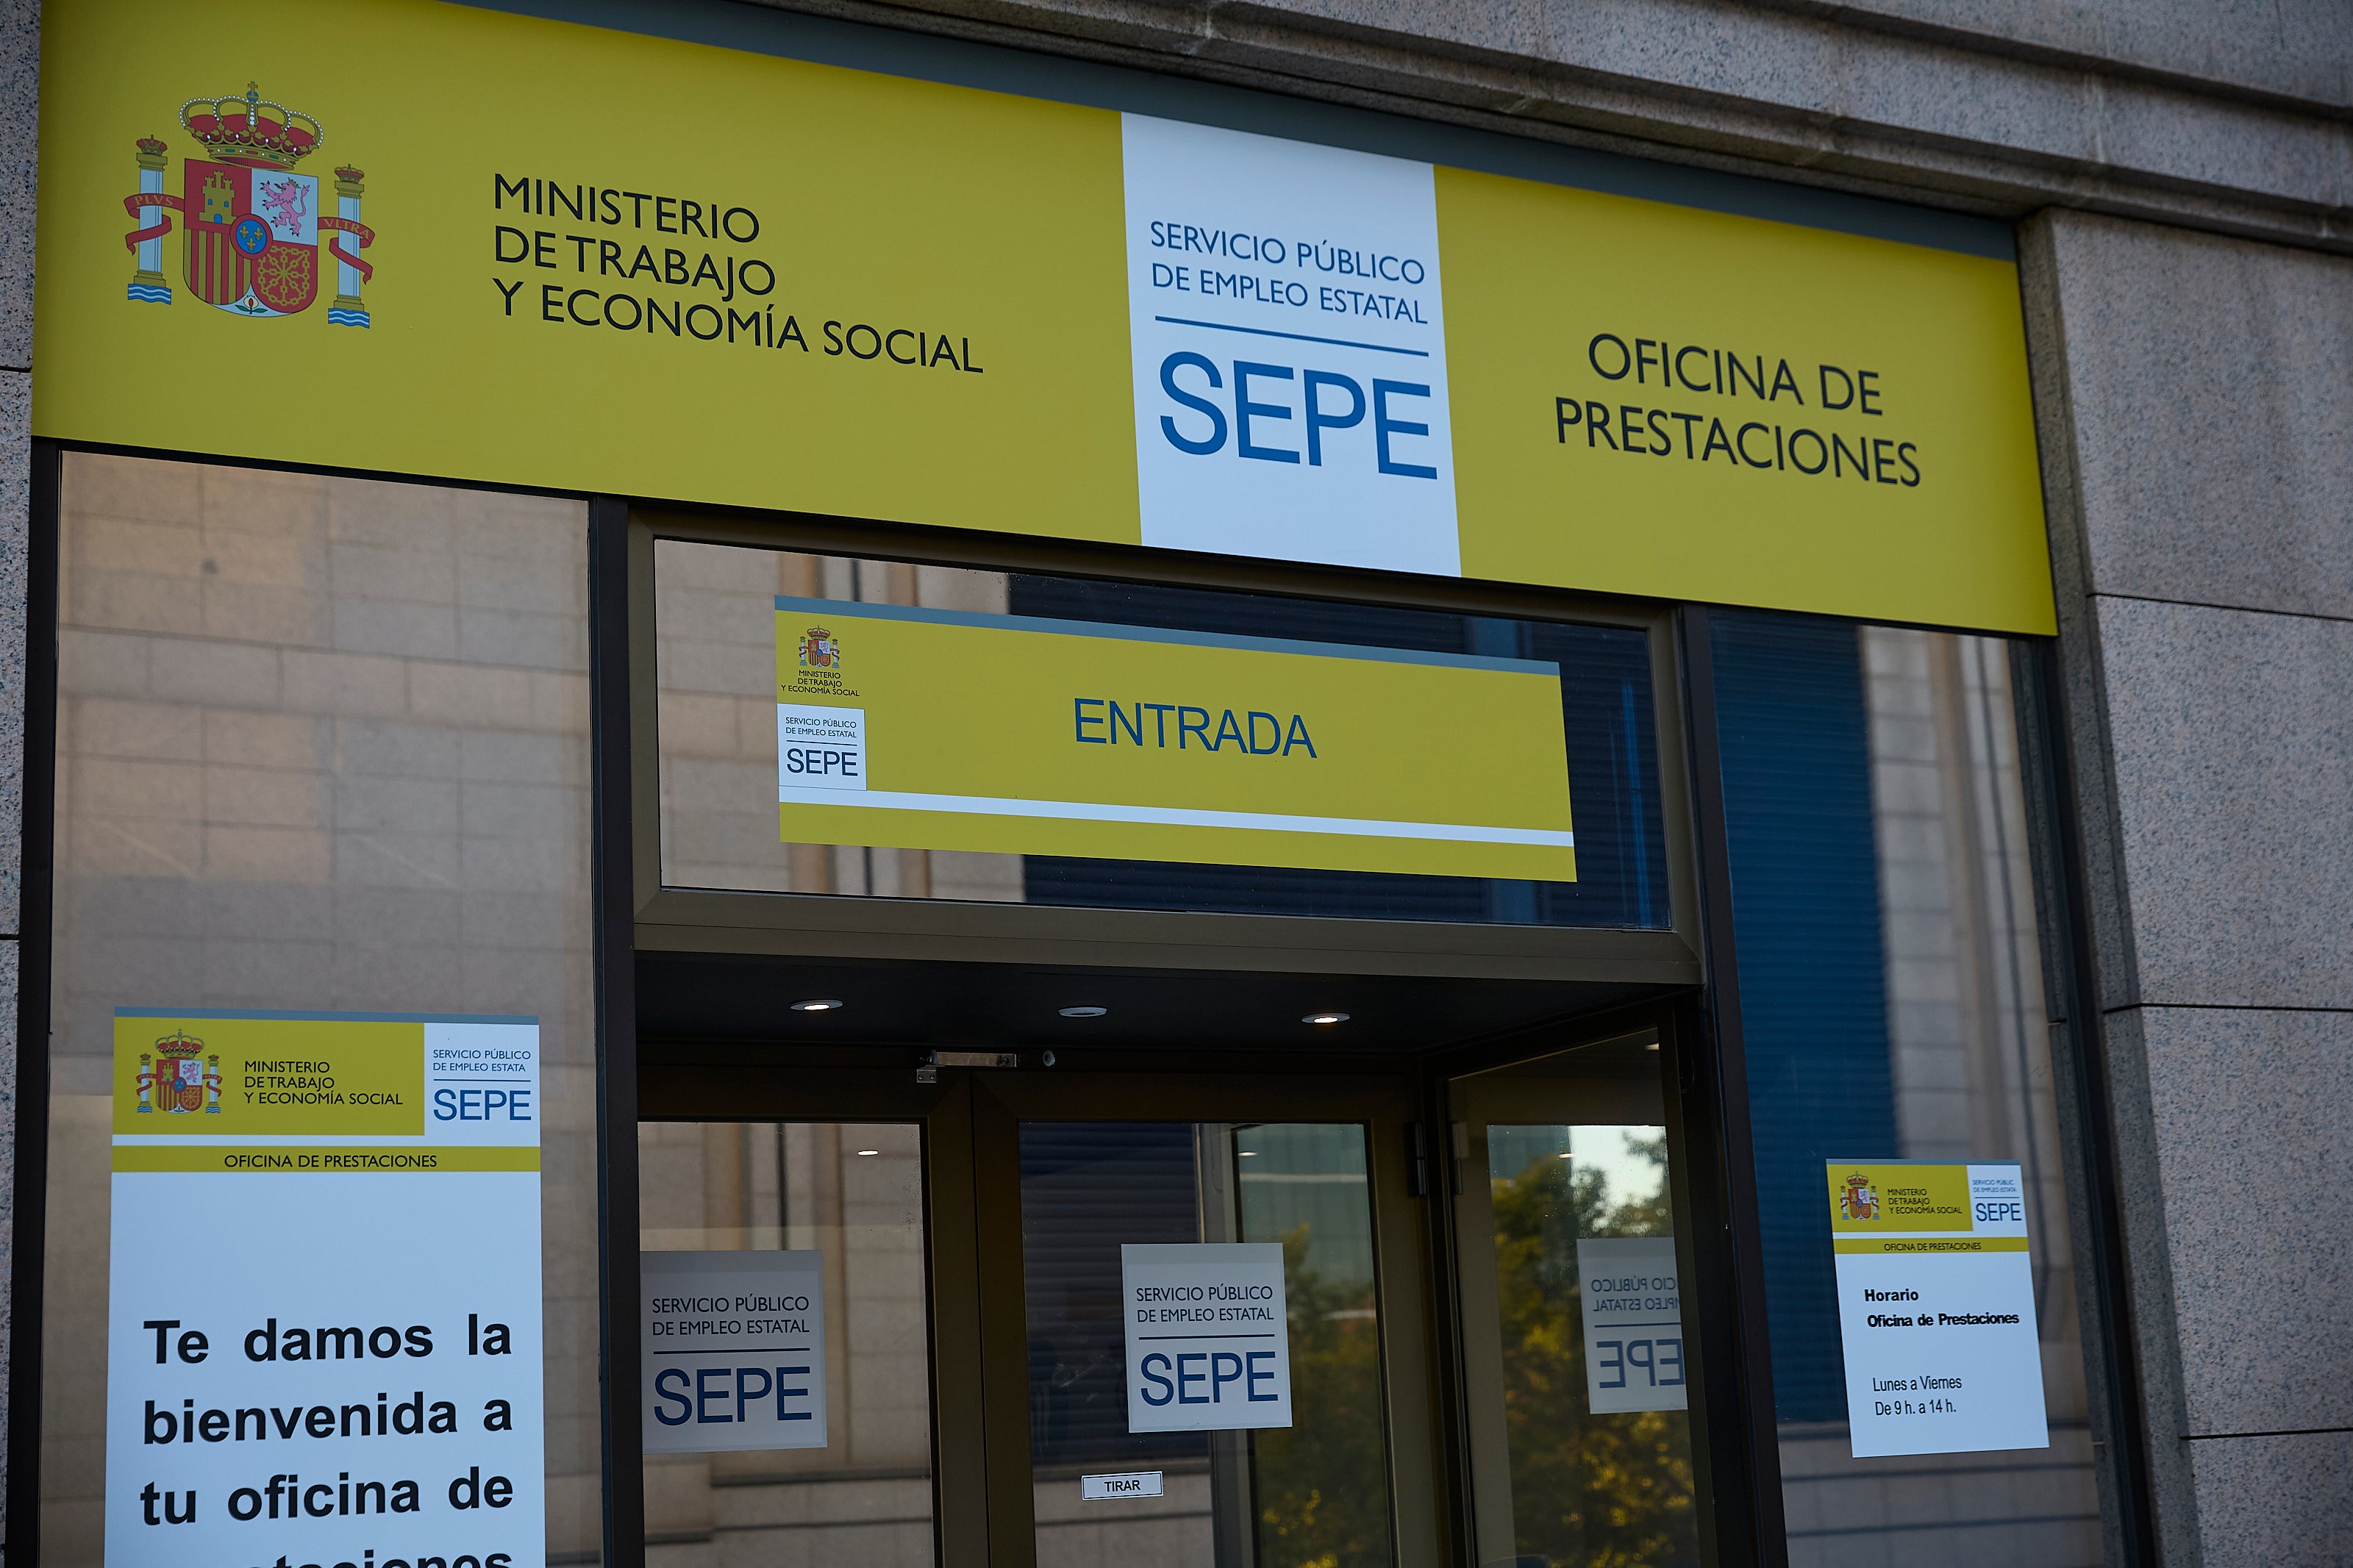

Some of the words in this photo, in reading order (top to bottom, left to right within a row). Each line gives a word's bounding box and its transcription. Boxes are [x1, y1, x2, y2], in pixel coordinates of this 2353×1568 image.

[134, 196, 174, 207] PLVS
[495, 173, 760, 243] MINISTERIO
[322, 218, 369, 237] VLTRA
[1150, 221, 1286, 264] SERVICIO
[1297, 240, 1425, 284] PÚBLICO
[495, 225, 557, 269] DE
[565, 234, 776, 302] TRABAJO
[1152, 262, 1190, 291] DE
[1200, 270, 1308, 307] EMPLEO
[1320, 287, 1428, 324] ESTATAL
[493, 277, 524, 316] Y
[542, 284, 809, 352] ECONOMÍA
[824, 321, 983, 373] SOCIAL
[1588, 333, 1804, 405] OFICINA
[1819, 364, 1883, 415] DE
[1160, 351, 1438, 480] SEPE
[1555, 396, 1921, 487] PRESTACIONES
[799, 670, 841, 679] MINISTERIO
[788, 685, 831, 695] ECONOMÍA
[832, 688, 860, 697] SOCIAL
[809, 679, 842, 688] TRABAJO
[785, 717, 821, 726] SERVICIO
[823, 718, 857, 728] PÚBLICO
[1074, 698, 1318, 759] ENTRADA
[798, 728, 826, 736] EMPLEO
[828, 730, 857, 738] ESTATAL
[787, 748, 858, 776] SEPE
[433, 1050, 481, 1059] SERVICIO
[485, 1048, 531, 1059] PÚBLICO
[244, 1060, 330, 1074] MINISTERIO
[433, 1063, 446, 1071] DE
[449, 1063, 488, 1071] EMPLEO
[491, 1064, 526, 1072] ESTATA
[244, 1076, 268, 1089] DE
[269, 1076, 335, 1092] TRABAJO
[244, 1092, 252, 1104] Y
[258, 1091, 345, 1105] ECONOMÍA
[349, 1093, 404, 1106] SOCIAL
[434, 1089, 532, 1121] SEPE
[224, 1155, 293, 1168] OFICINA
[298, 1155, 319, 1167] DE
[324, 1155, 438, 1168] PRESTACIONES
[1887, 1188, 1927, 1196] MINISTERIO
[1896, 1206, 1935, 1214] ECONOMÍA
[1898, 1198, 1930, 1206] TRABAJO
[1976, 1203, 2022, 1221] SEPE
[1884, 1243, 1915, 1251] OFICINA
[1917, 1242, 1928, 1250] DE
[1929, 1242, 1982, 1250] PRESTACIONES
[1136, 1286, 1204, 1302] SERVICIO
[1209, 1283, 1273, 1301] PÚBLICO
[1864, 1289, 1918, 1302] Horario
[652, 1297, 729, 1314] SERVICIO
[735, 1294, 809, 1312] PÚBLICO
[1137, 1309, 1157, 1322] DE
[1160, 1308, 1215, 1322] EMPLEO
[1218, 1307, 1274, 1321] ESTATAL
[1867, 1314, 1913, 1328] Oficina
[1918, 1314, 1934, 1326] de
[1939, 1312, 2019, 1325] Prestaciones
[652, 1321, 674, 1336] DE
[679, 1320, 741, 1335] EMPLEO
[747, 1319, 810, 1334] ESTATAL
[143, 1320, 209, 1364] Te
[243, 1317, 433, 1362] damos
[468, 1314, 512, 1356] la
[1140, 1351, 1279, 1406] SEPE
[1873, 1377, 1907, 1392] Lunes
[1910, 1380, 1918, 1390] a
[1919, 1375, 1962, 1390] Viernes
[654, 1366, 812, 1426] SEPE
[1875, 1401, 1891, 1416] De
[1894, 1401, 1902, 1415] 9
[1904, 1400, 1915, 1414] h.
[1918, 1403, 1925, 1414] a
[1929, 1400, 1943, 1413] 14
[1946, 1399, 1957, 1413] h.
[144, 1391, 457, 1445] bienvenida
[482, 1398, 513, 1431] a
[1104, 1480, 1141, 1493] TIRAR
[140, 1481, 196, 1526] tu
[227, 1472, 421, 1522] oficina
[448, 1466, 513, 1510] de
